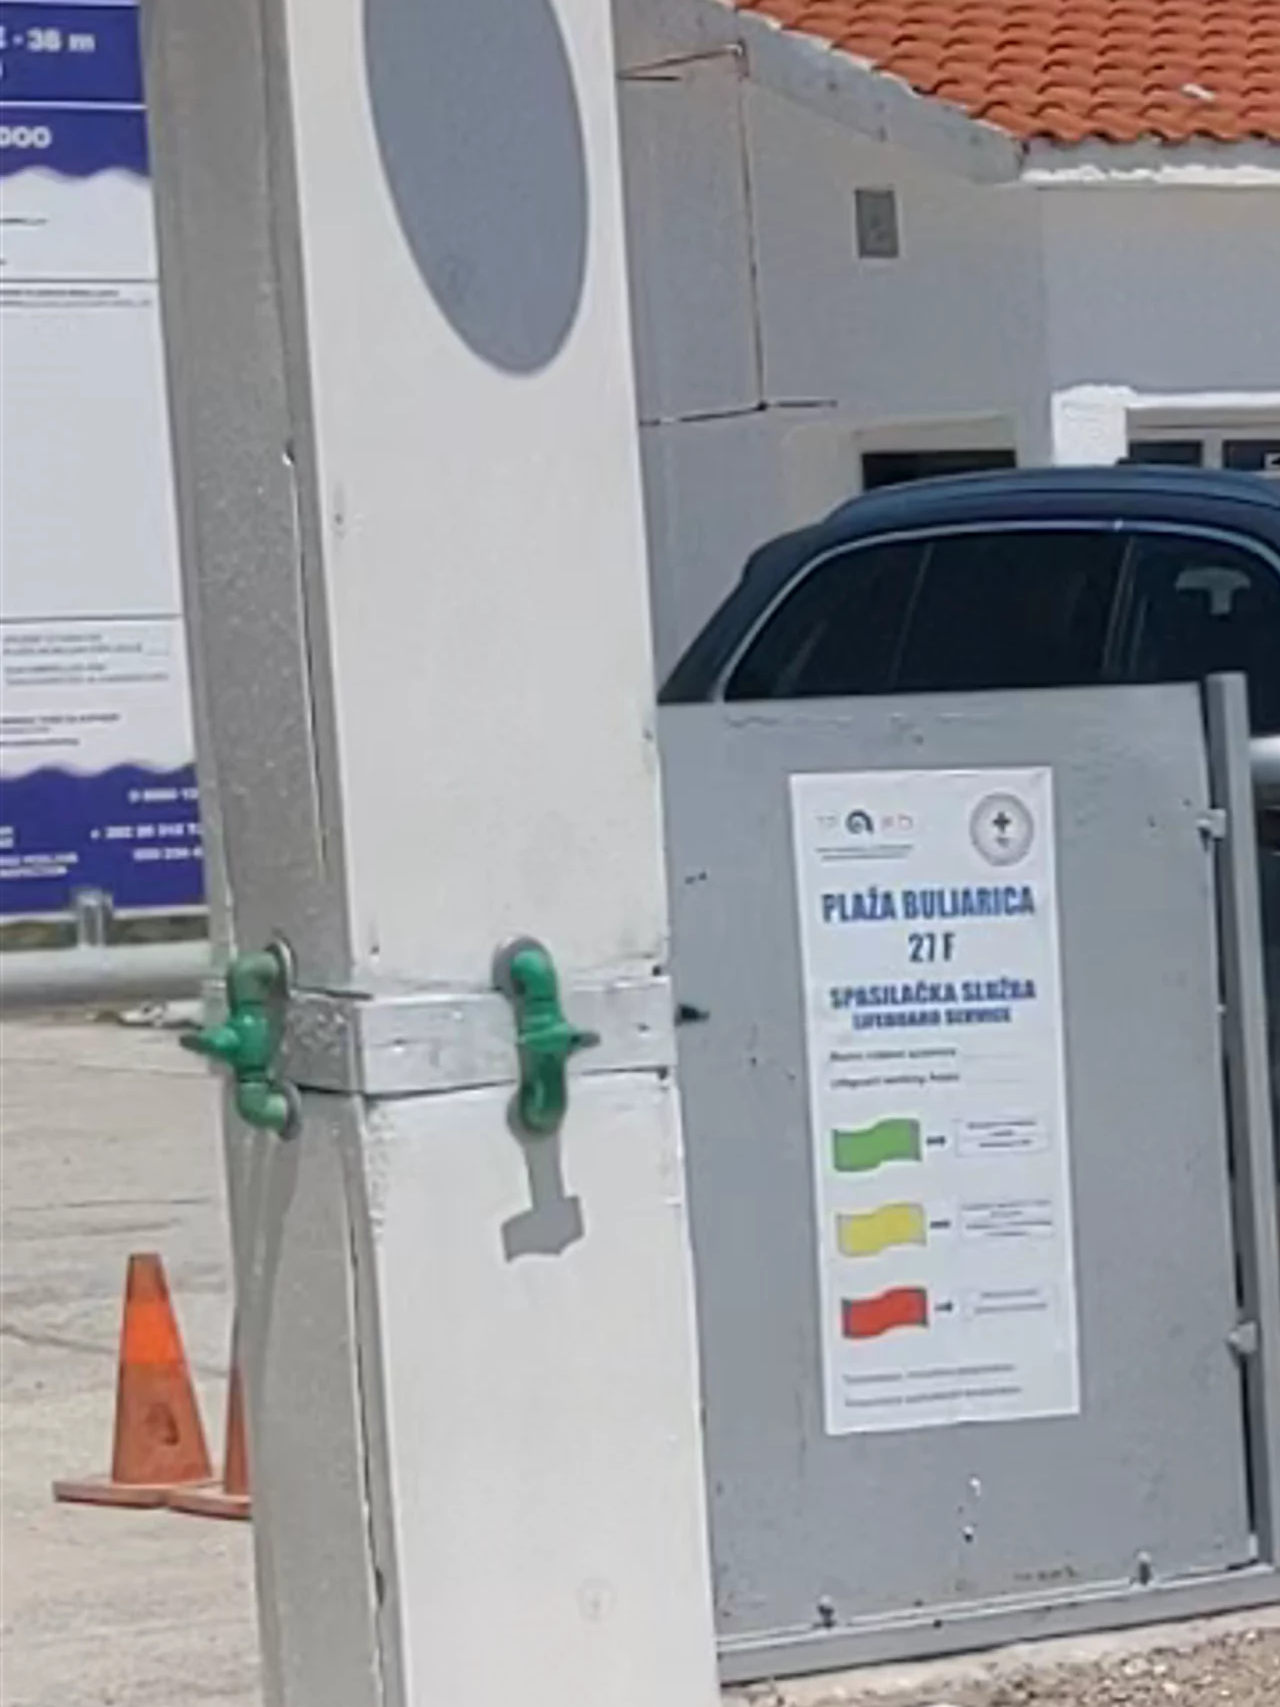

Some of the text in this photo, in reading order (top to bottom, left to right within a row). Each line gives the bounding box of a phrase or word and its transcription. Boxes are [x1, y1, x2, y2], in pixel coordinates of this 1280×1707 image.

[821, 885, 1035, 923] PLAŽA BULJARICA
[908, 931, 956, 963] 27 F
[830, 975, 1037, 1009] SPASILAČKA SLUŽBA
